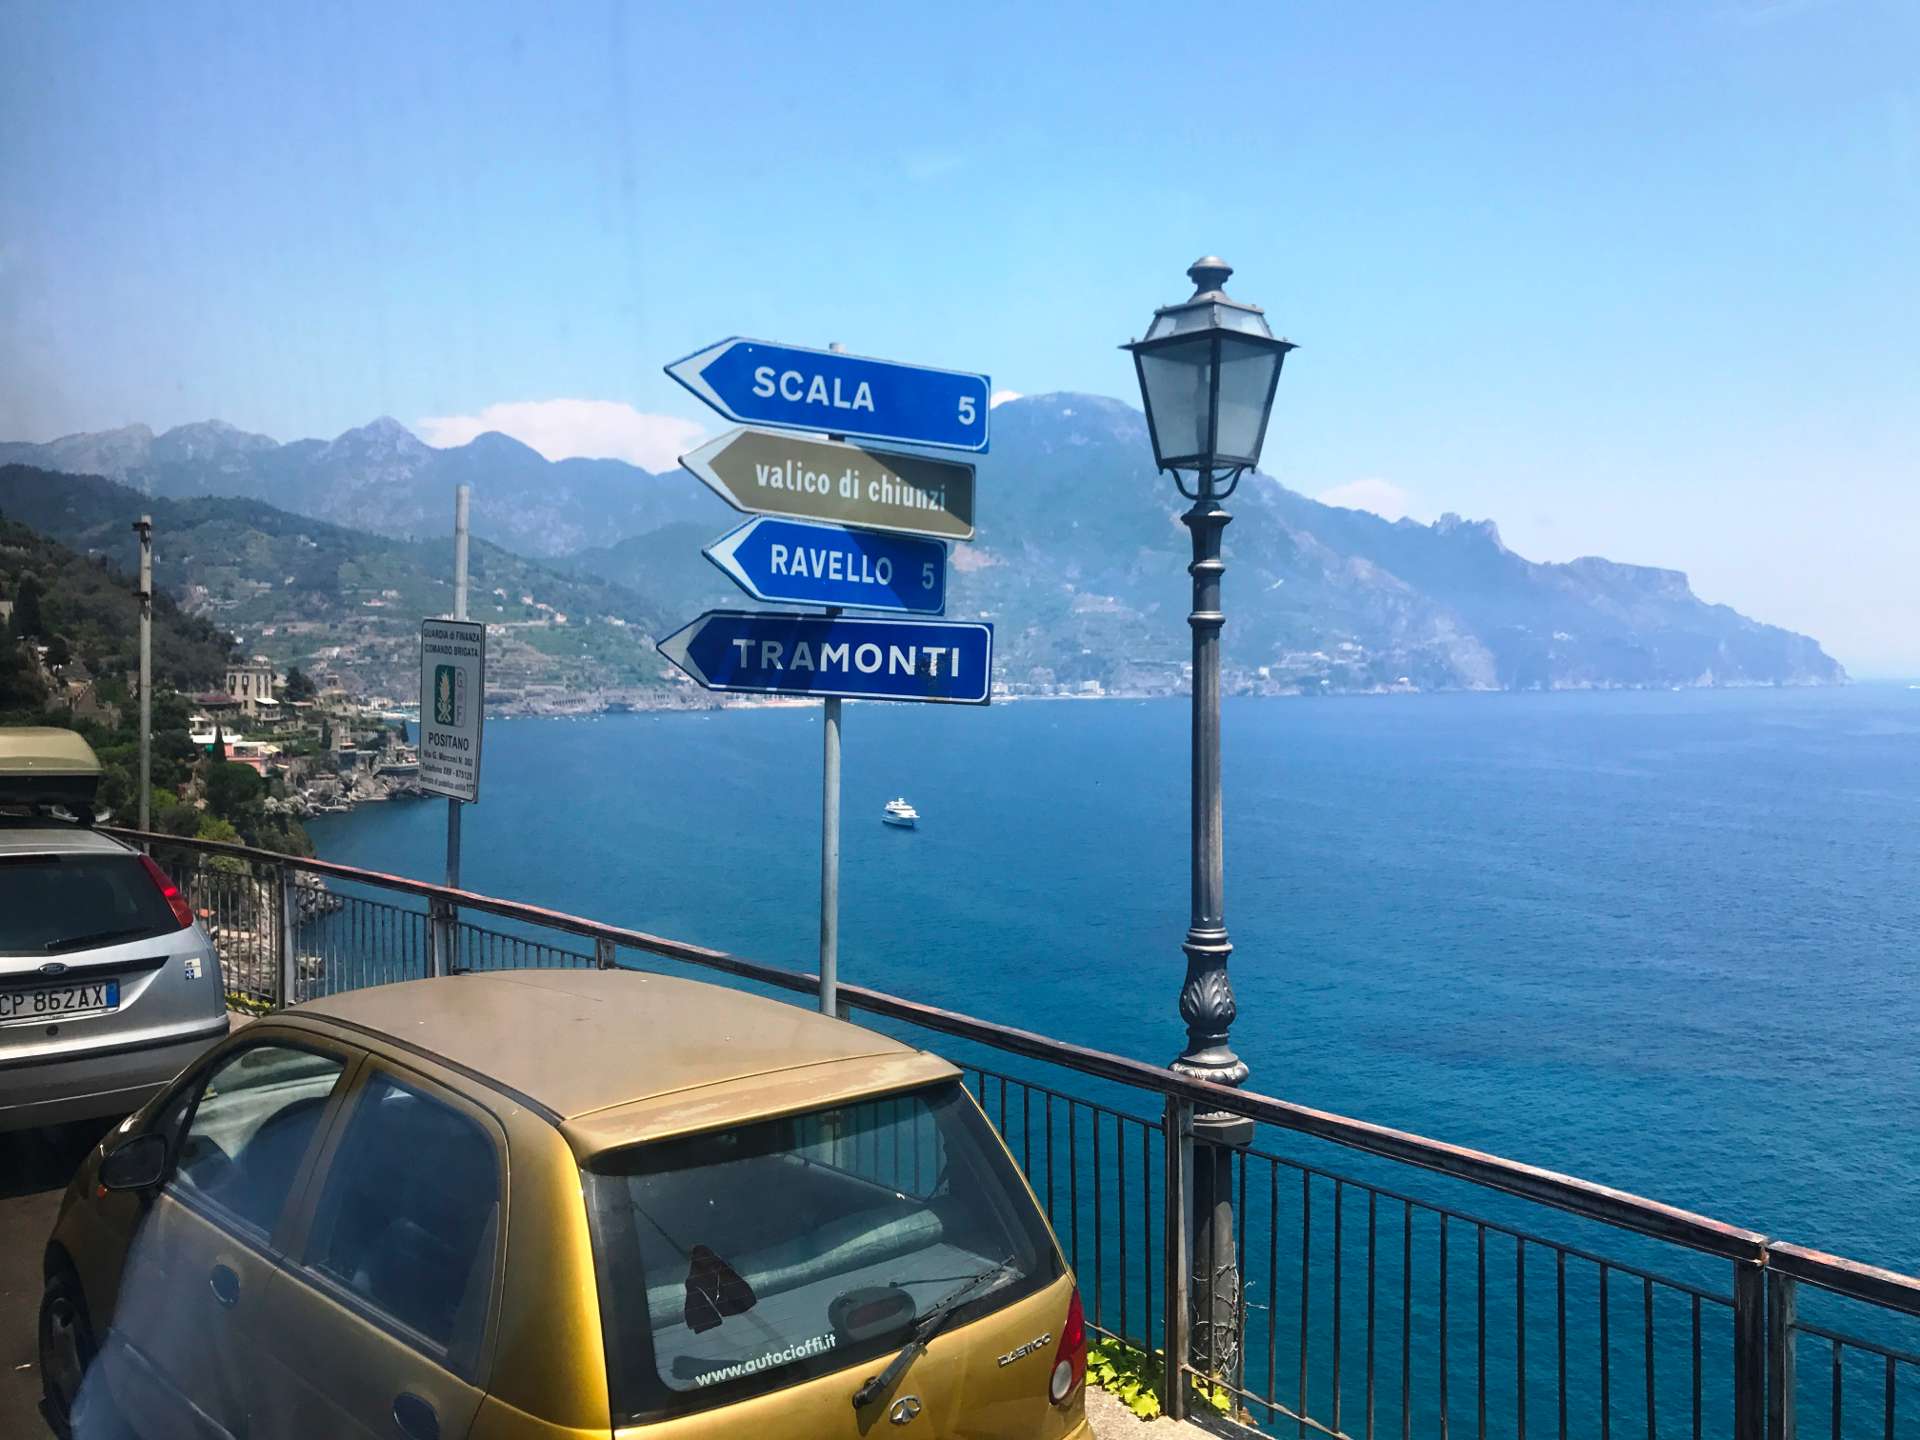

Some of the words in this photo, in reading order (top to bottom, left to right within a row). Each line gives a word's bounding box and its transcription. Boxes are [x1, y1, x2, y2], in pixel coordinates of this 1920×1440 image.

[752, 366, 875, 412] SCALA
[958, 396, 976, 425] 5
[755, 460, 830, 495] valico
[839, 470, 860, 500] di
[868, 475, 946, 511] chiunzi
[770, 543, 893, 585] RAVELLO
[921, 562, 935, 590] 5
[453, 646, 479, 657] BRIGATA
[455, 630, 480, 641] FINANZA
[732, 637, 960, 677] TRAMONTI
[428, 732, 469, 751] POSITANO
[33, 985, 104, 1012] 862AX
[695, 1333, 837, 1387] www.autocioffi.it
